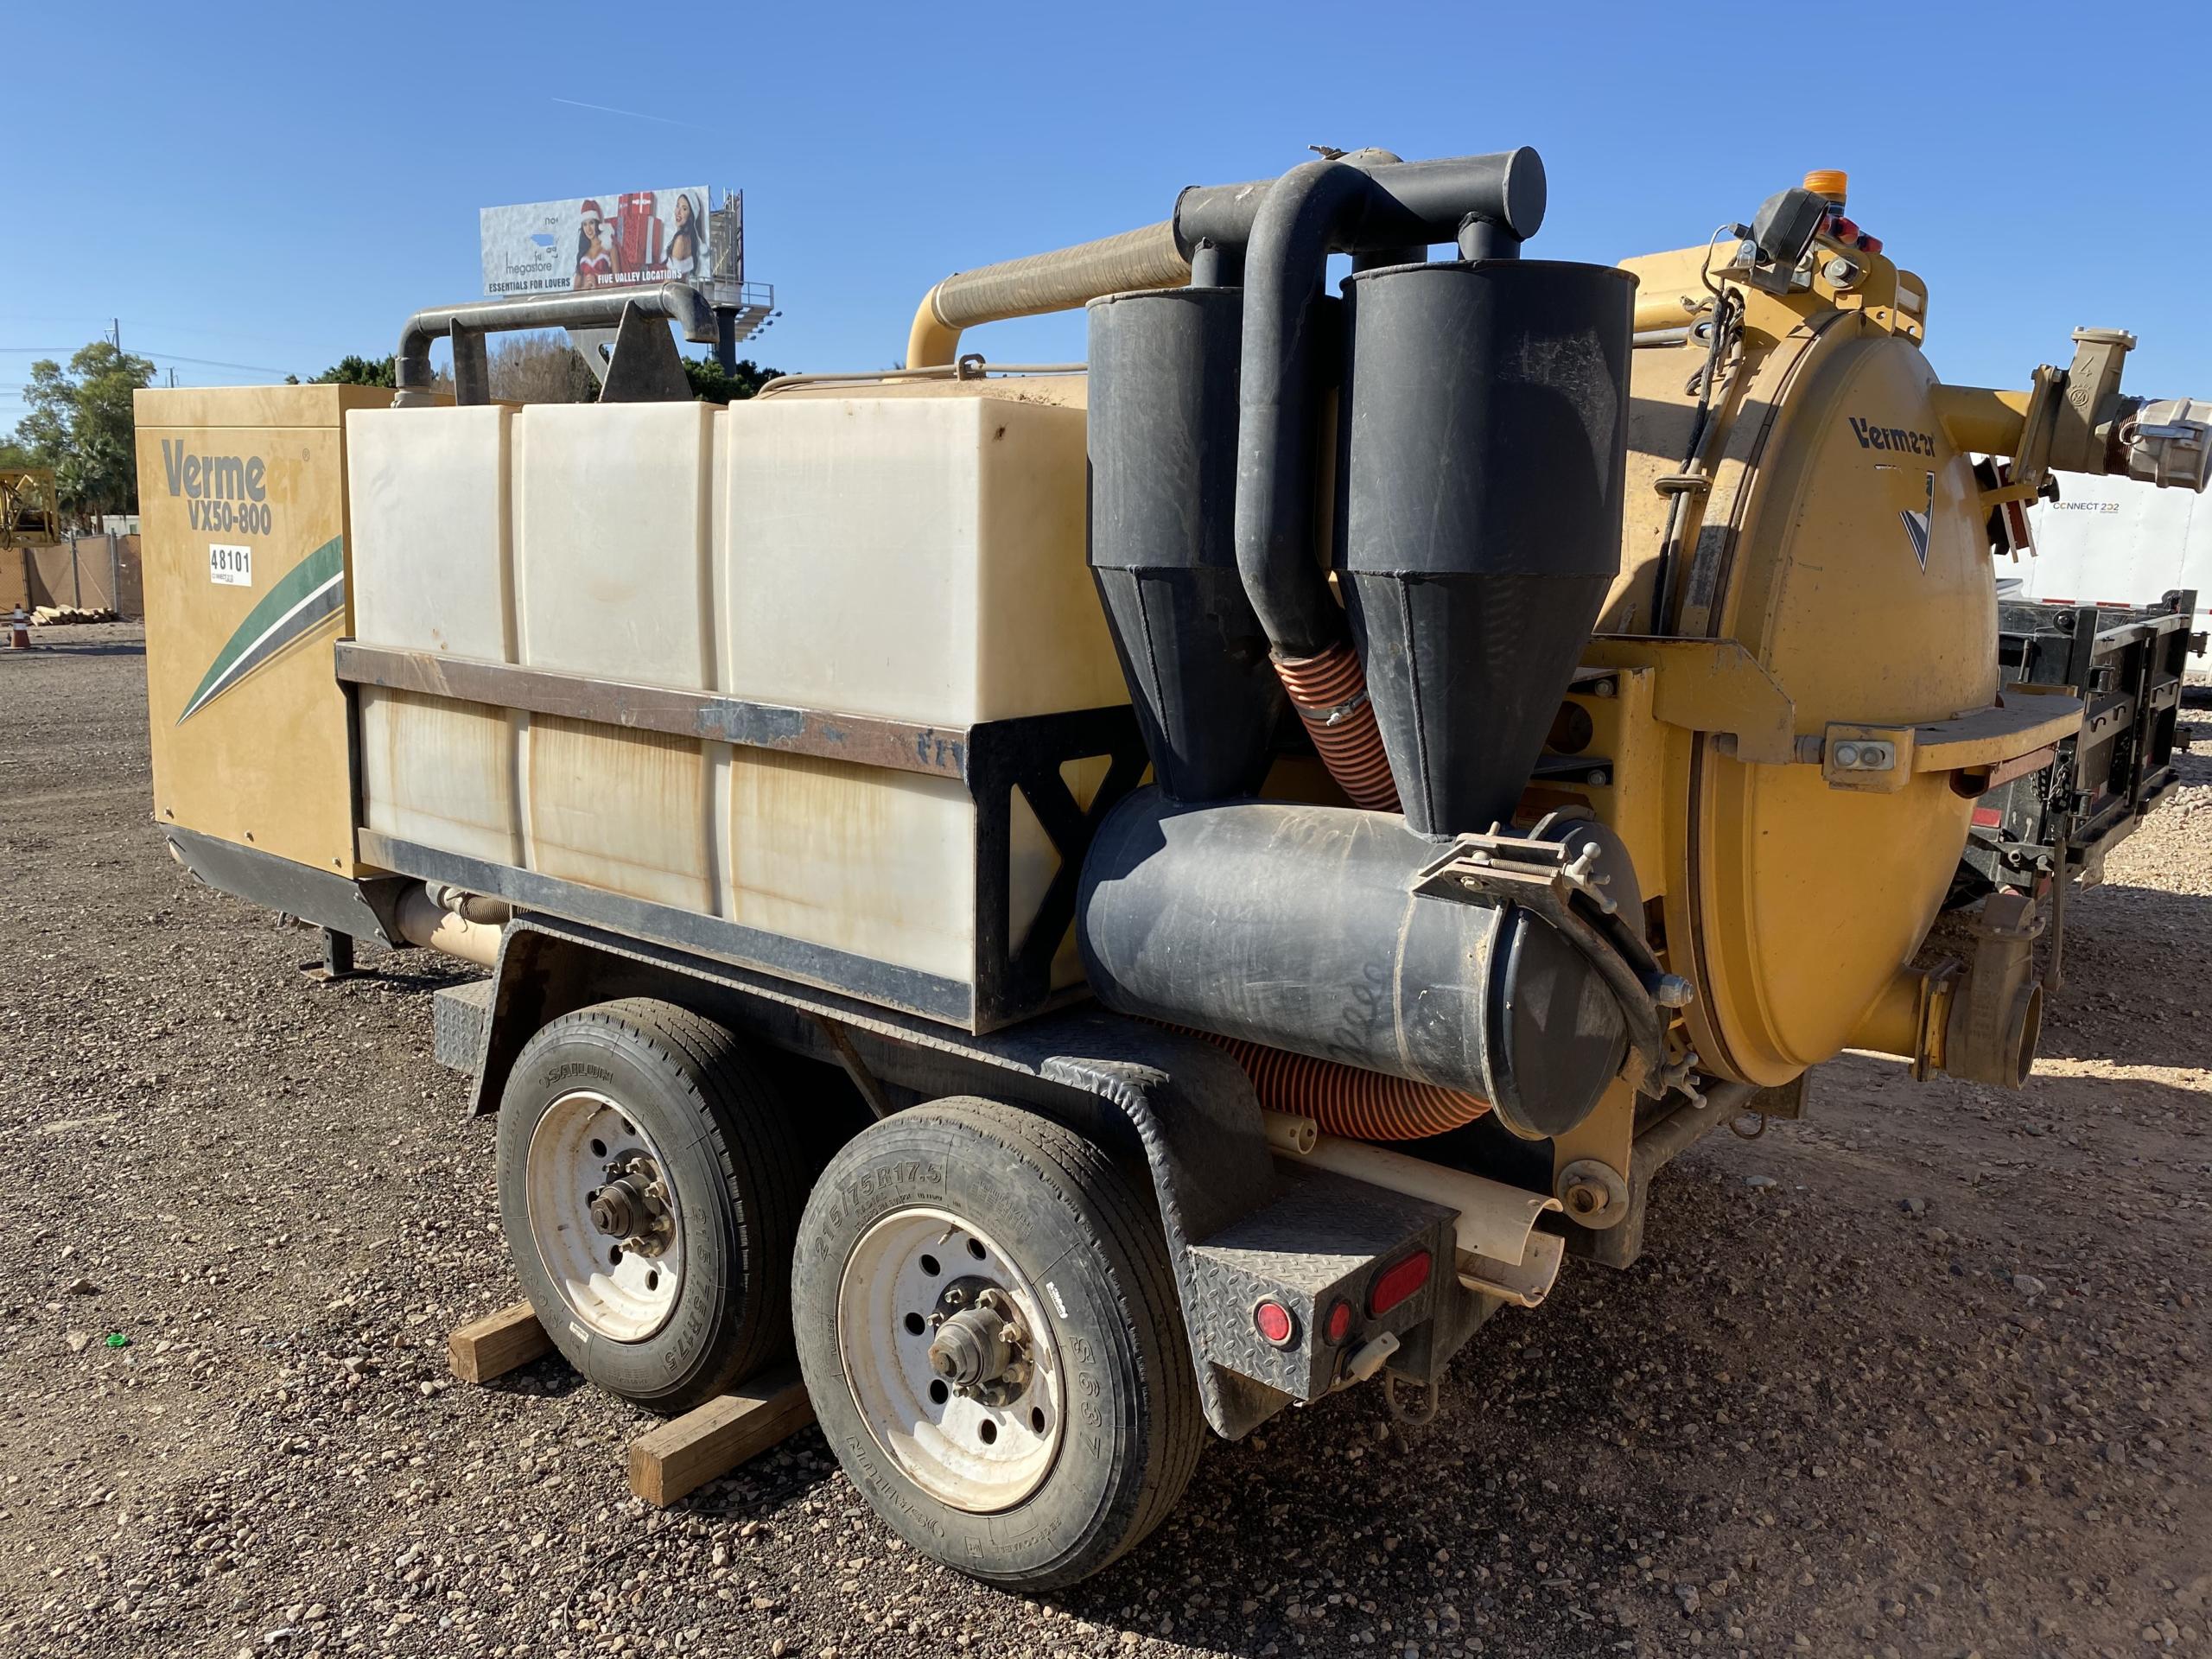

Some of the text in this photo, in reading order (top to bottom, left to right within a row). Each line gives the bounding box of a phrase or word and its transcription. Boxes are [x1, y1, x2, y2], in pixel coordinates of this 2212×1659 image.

[505, 262, 552, 276] megastore
[598, 269, 683, 284] FIVE VALLEY LOCATIONS
[489, 277, 570, 293] ESSENTIALS FOR LOVERS
[187, 499, 272, 536] VX50-800
[211, 550, 249, 574] 48101
[814, 1160, 943, 1262] 215/75R17.5
